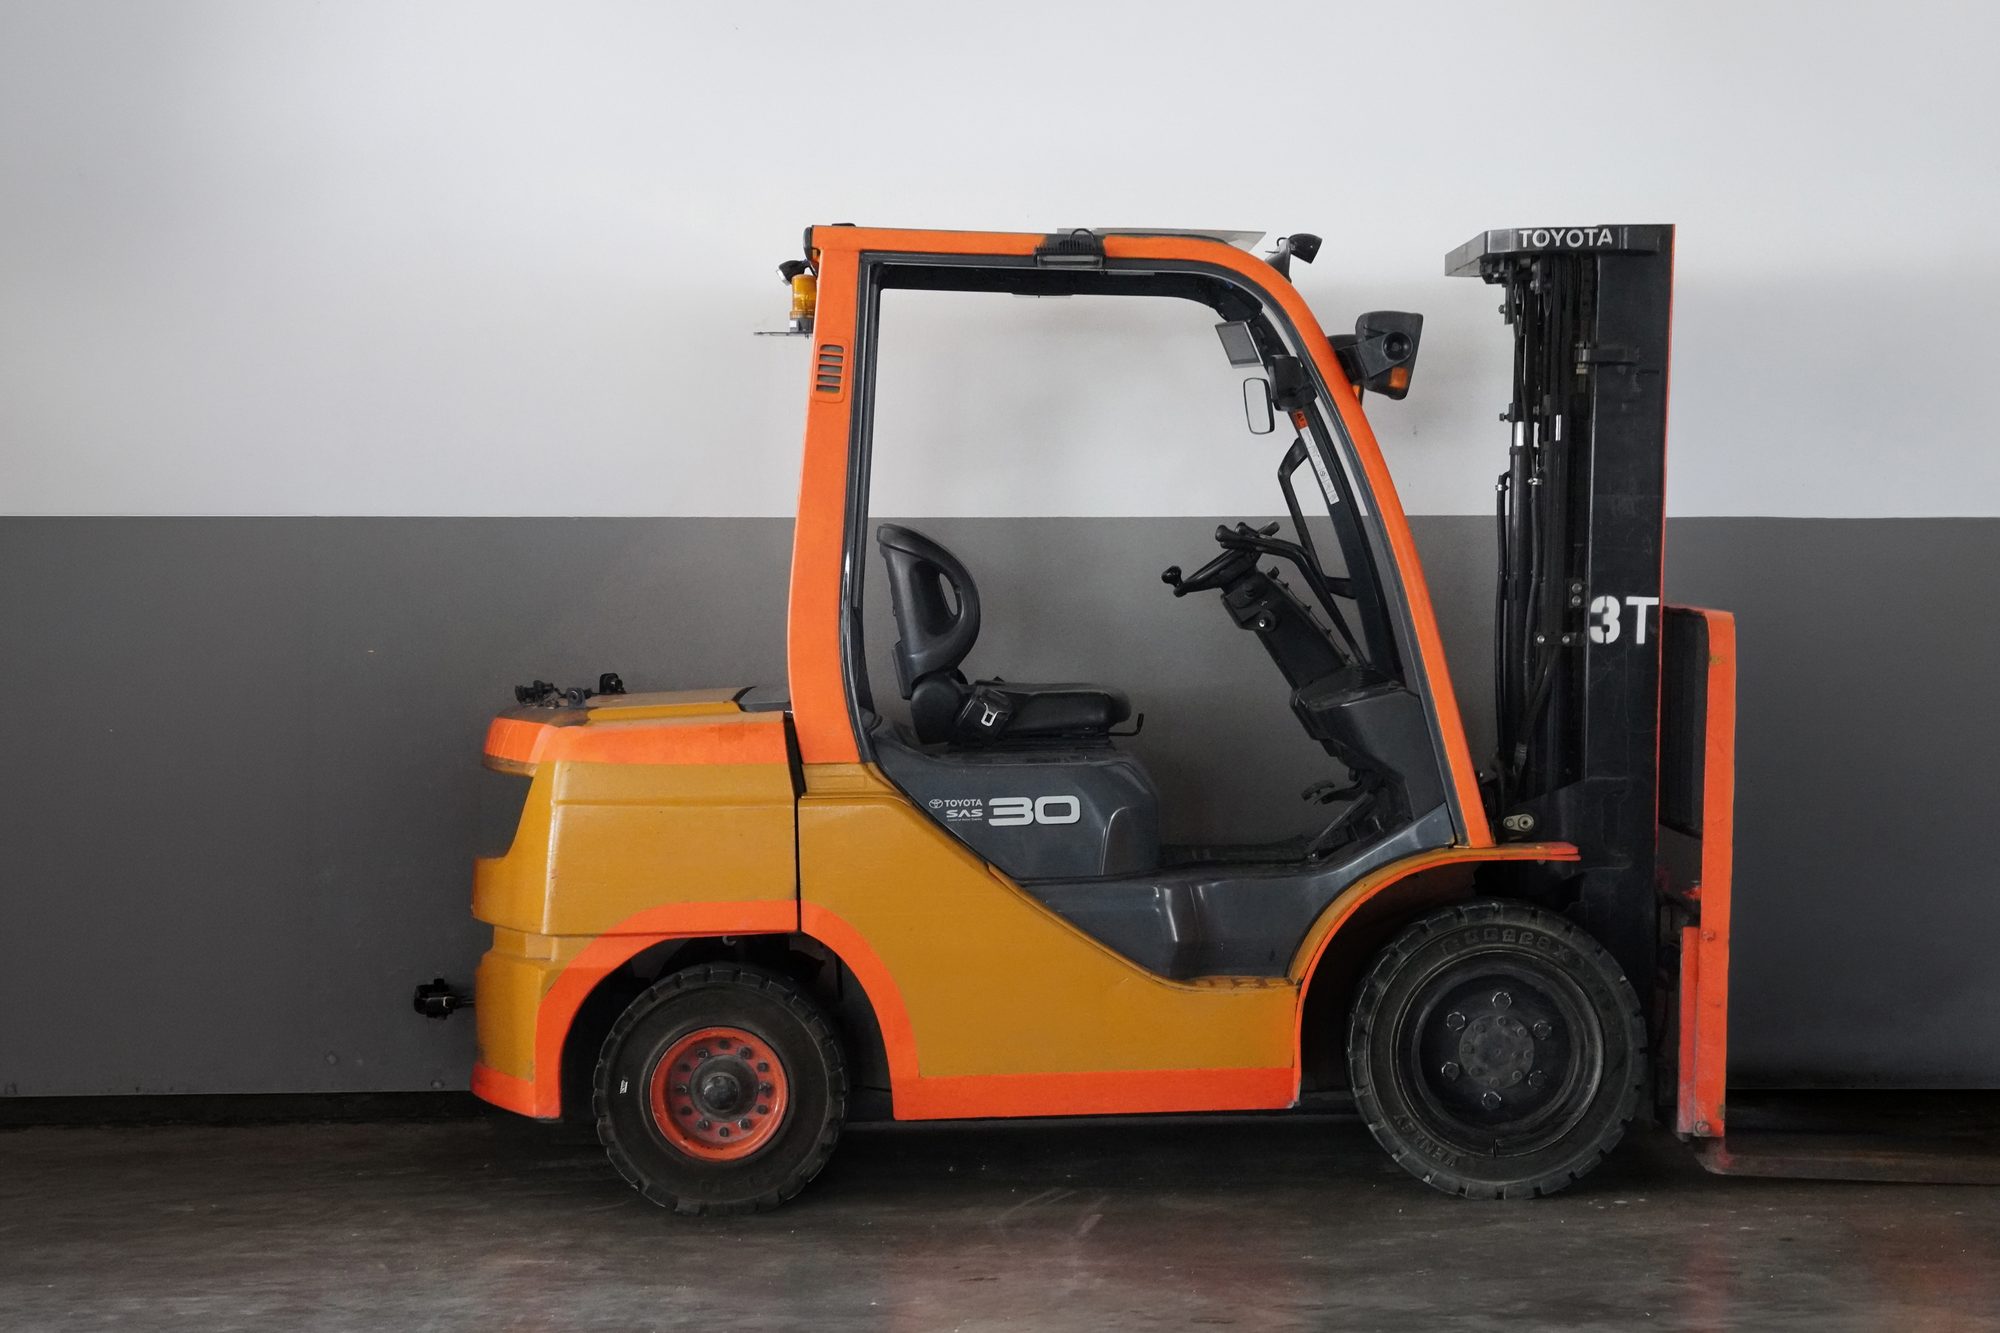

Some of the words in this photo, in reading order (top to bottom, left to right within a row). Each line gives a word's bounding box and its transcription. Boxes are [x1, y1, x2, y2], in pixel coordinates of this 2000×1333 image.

[1519, 228, 1613, 248] TOYOTA
[1589, 595, 1660, 645] 3T
[944, 798, 983, 808] TOYOTA
[946, 808, 983, 818] SAS
[988, 795, 1081, 826] 30
